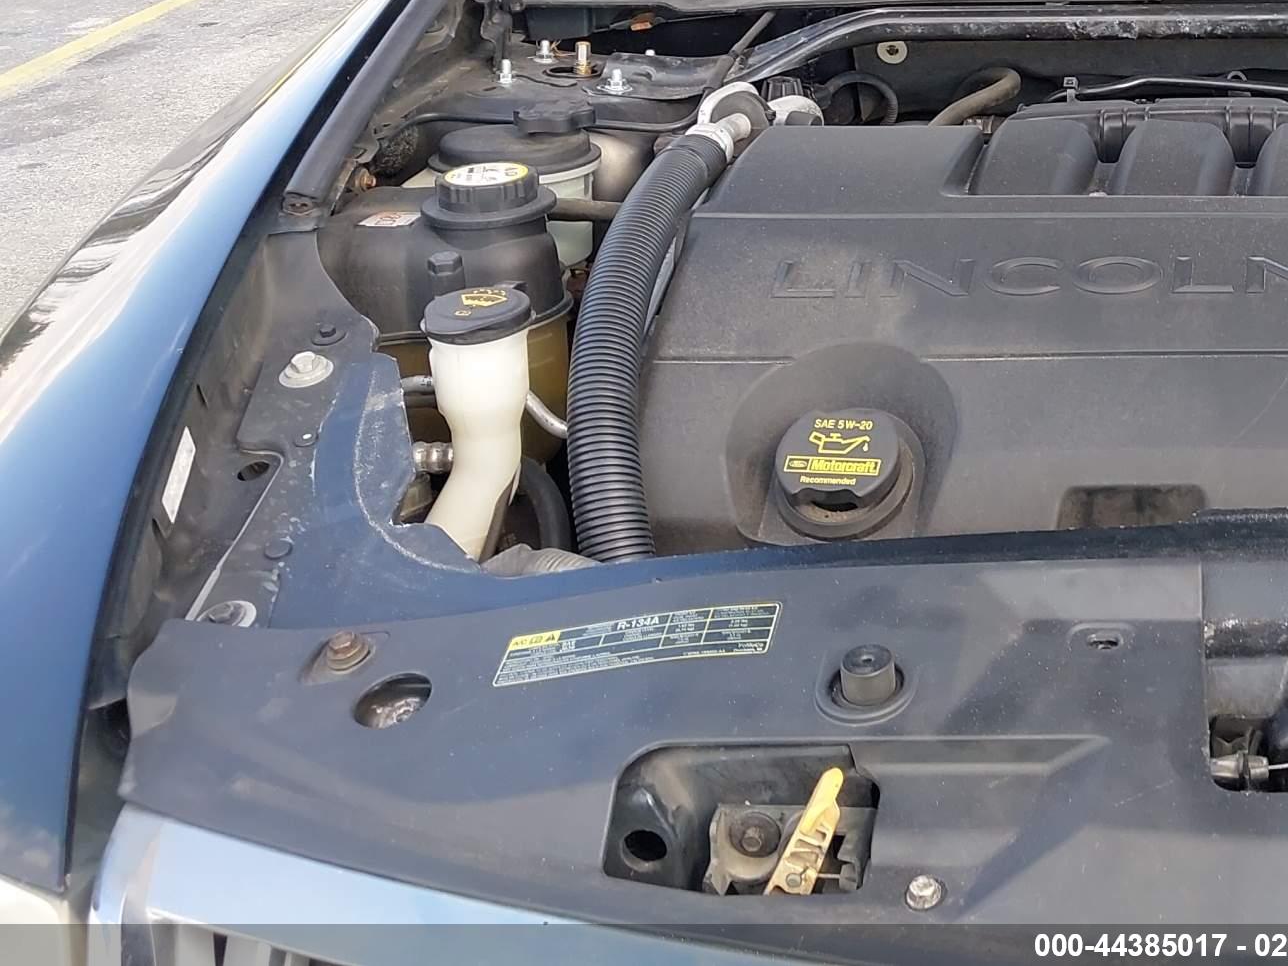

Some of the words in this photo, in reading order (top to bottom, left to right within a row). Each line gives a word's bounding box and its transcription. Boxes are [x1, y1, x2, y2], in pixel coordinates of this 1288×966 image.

[814, 418, 836, 429] SAE
[810, 458, 877, 474] Motorcraft
[799, 475, 857, 486] Recommended
[616, 615, 660, 631] R-134A
